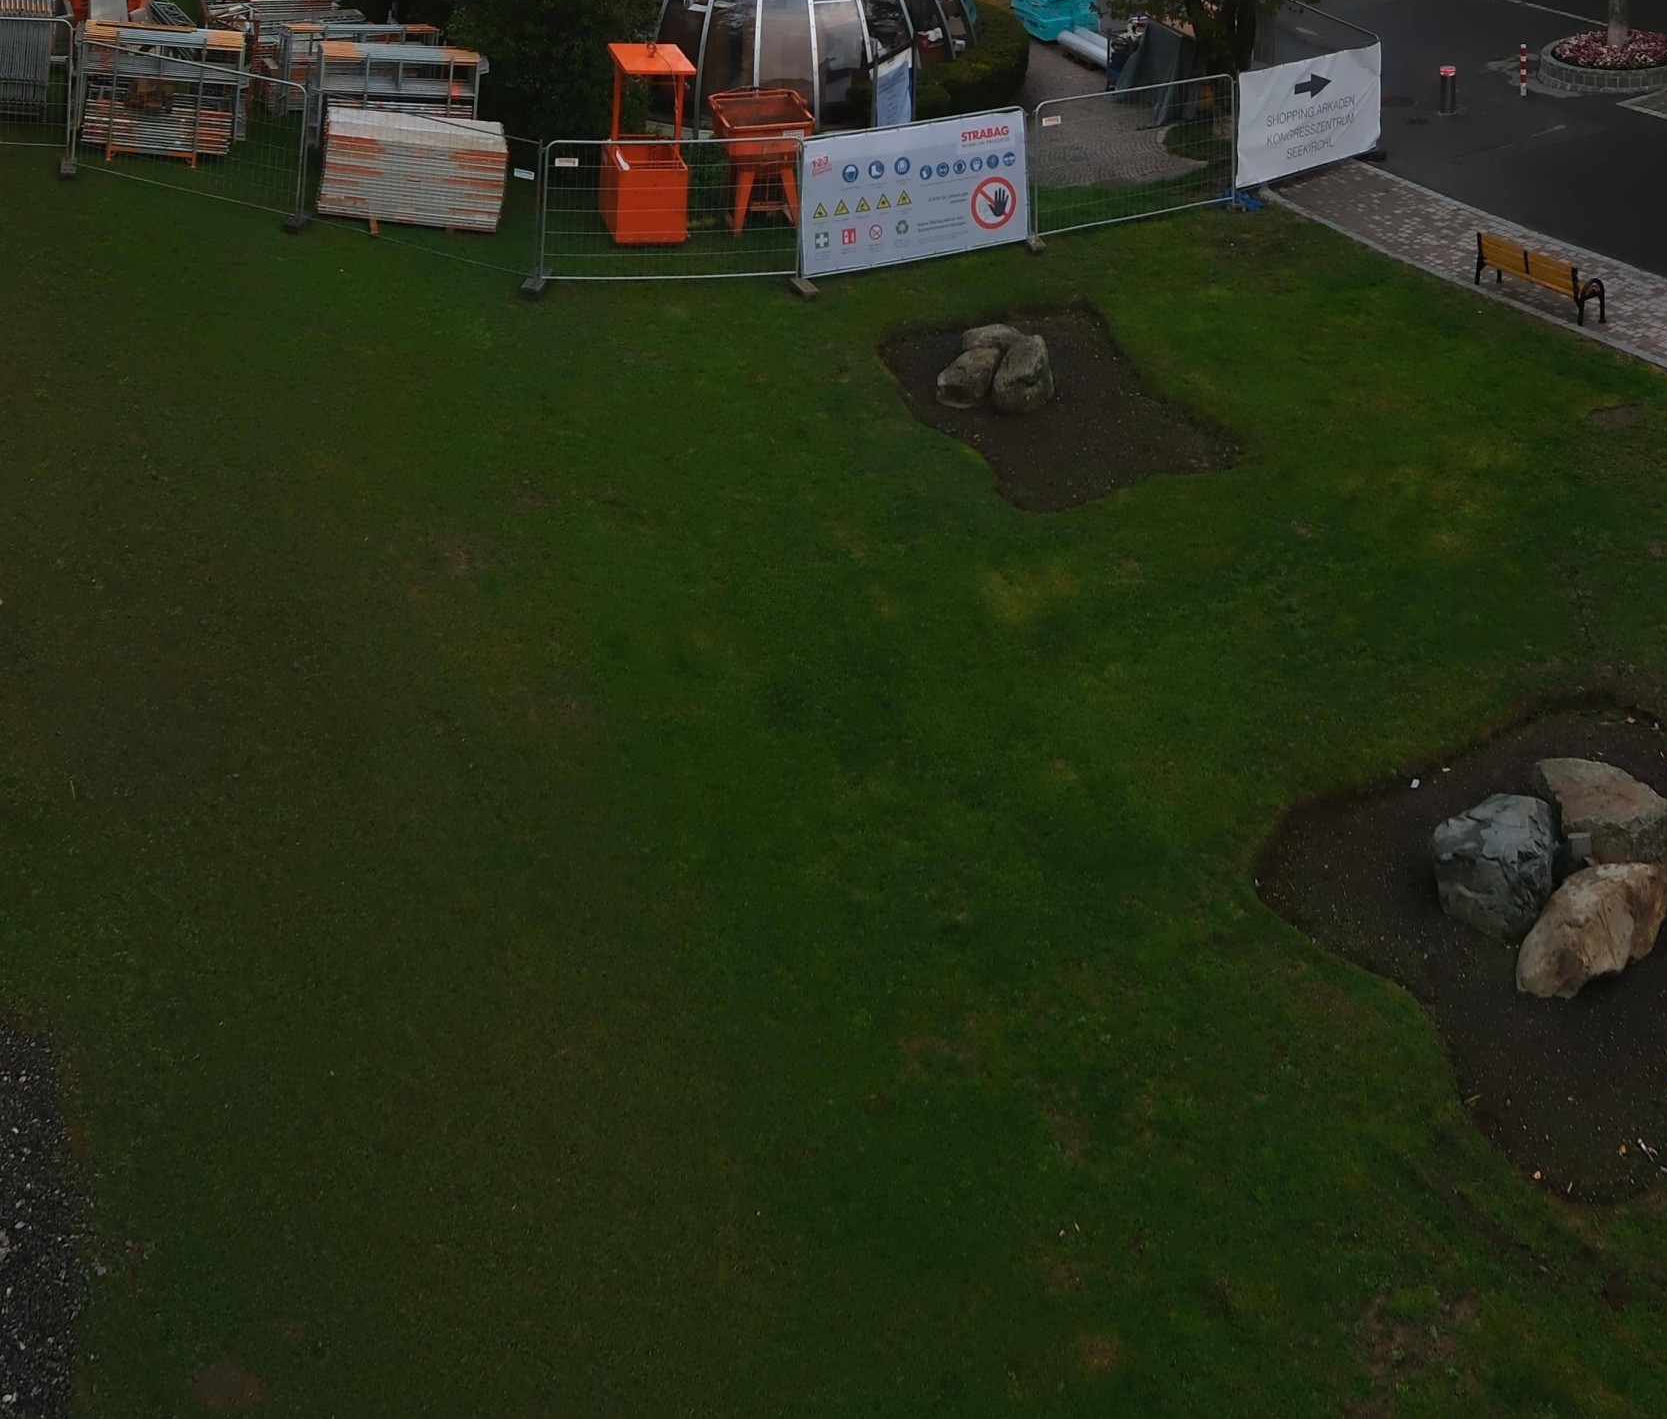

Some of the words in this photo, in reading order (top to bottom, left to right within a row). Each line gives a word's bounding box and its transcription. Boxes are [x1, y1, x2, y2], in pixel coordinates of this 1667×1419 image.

[1266, 106, 1315, 127] SHOPPING
[1316, 95, 1355, 114] ARKADEN
[961, 125, 1010, 142] STRABAG
[1266, 113, 1355, 146] KONGRESSZENTRUM
[1286, 138, 1334, 160] SEEKIRCHL
